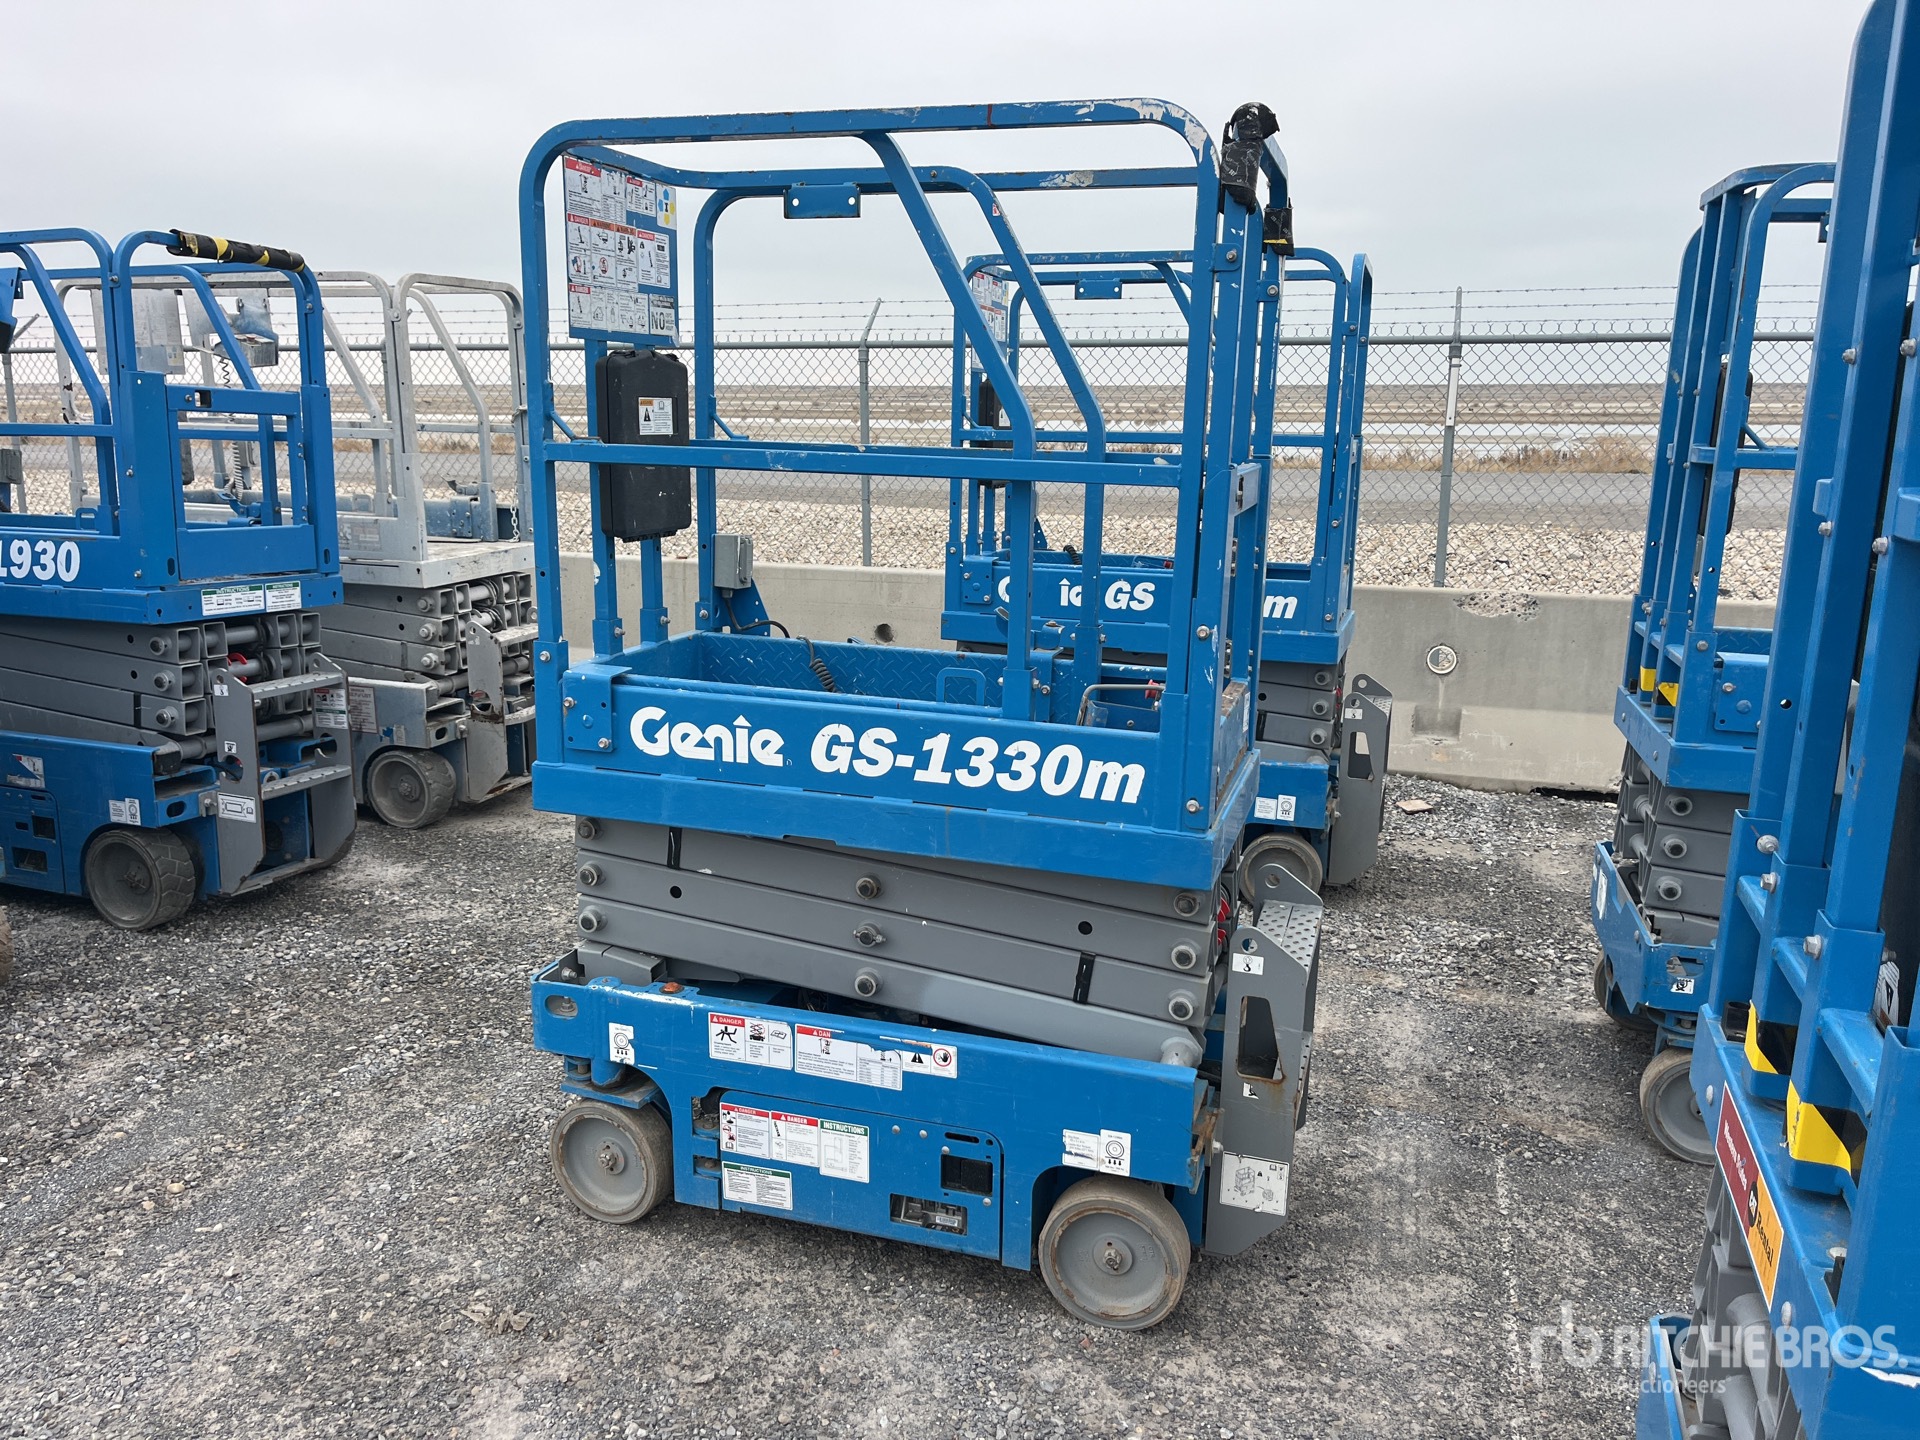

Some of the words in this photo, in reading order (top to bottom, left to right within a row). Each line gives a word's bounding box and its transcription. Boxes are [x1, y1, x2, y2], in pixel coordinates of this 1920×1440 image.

[810, 723, 1146, 804] GS-1330m
[718, 1016, 742, 1025] DANGER
[818, 1030, 831, 1038] DAN
[738, 1107, 757, 1115] DANGER
[786, 1115, 808, 1125] DANGER
[823, 1121, 865, 1135] INSTRUCTIONS
[740, 1166, 773, 1175] INSTRUCTIONS
[1756, 1211, 1774, 1267] Rental
